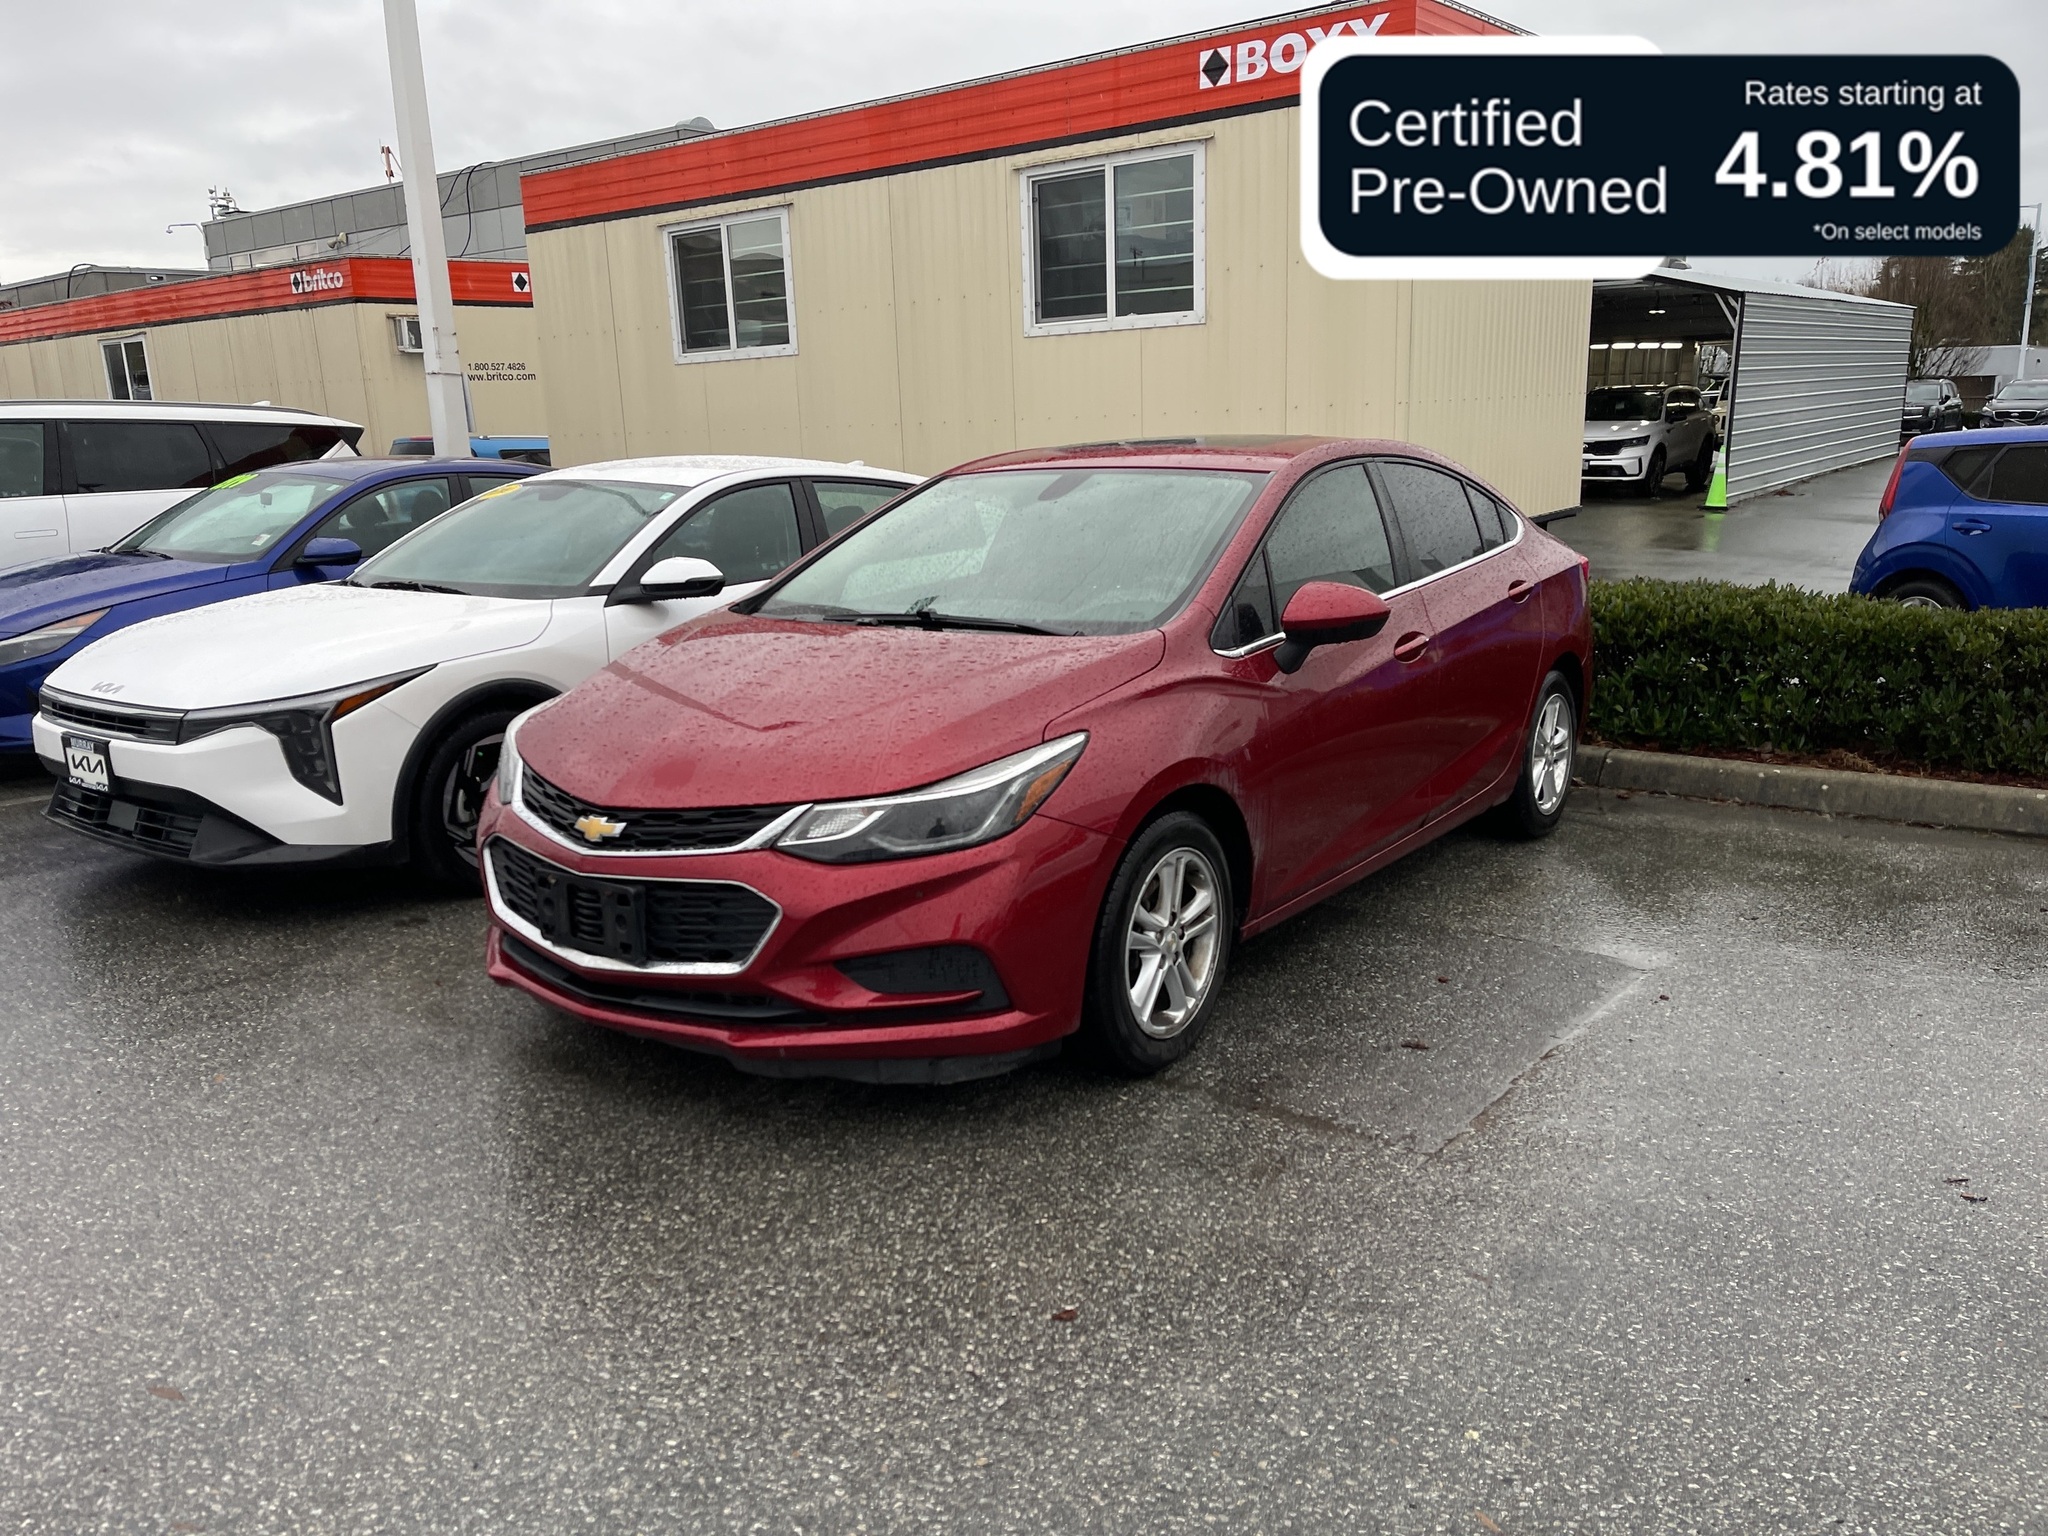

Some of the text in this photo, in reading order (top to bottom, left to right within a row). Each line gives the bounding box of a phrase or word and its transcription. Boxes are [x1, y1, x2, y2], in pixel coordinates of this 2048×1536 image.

[302, 268, 343, 292] britco
[467, 362, 526, 371] 1.800.527.4826
[466, 372, 537, 381] ww.britco.com
[91, 681, 125, 694] KIA
[71, 753, 104, 775] KIA
